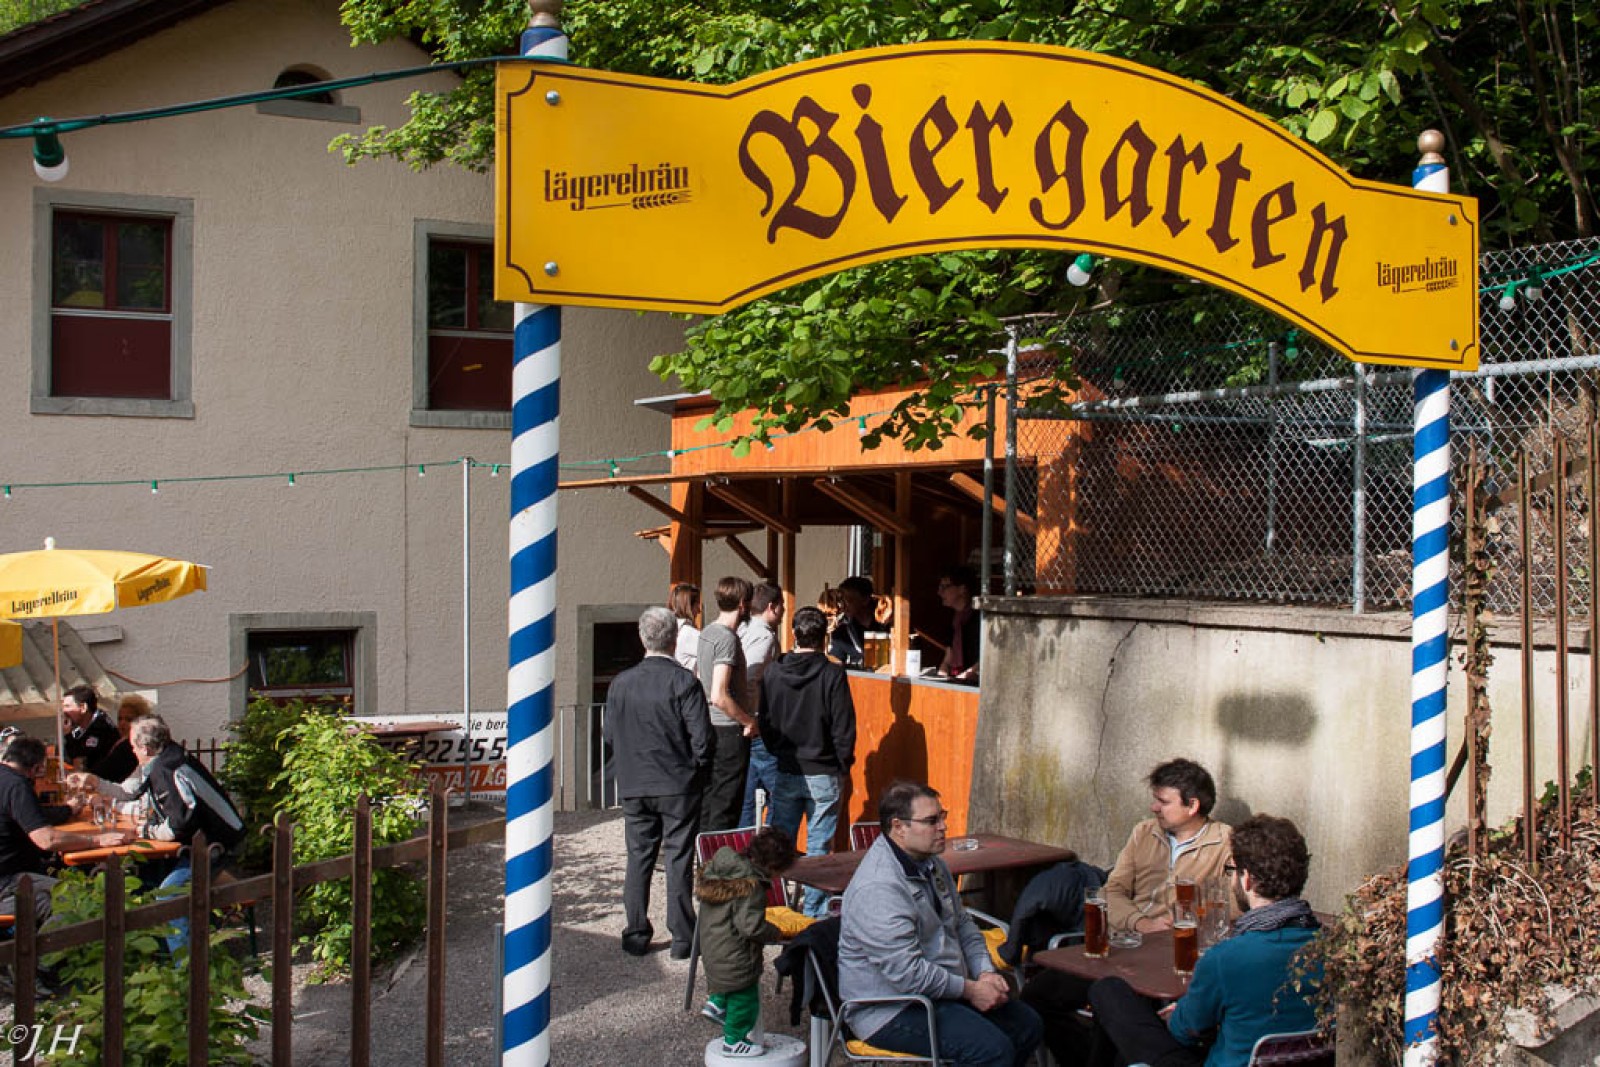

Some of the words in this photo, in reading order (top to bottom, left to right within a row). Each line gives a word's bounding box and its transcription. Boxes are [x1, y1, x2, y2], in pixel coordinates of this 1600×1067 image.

[739, 84, 1348, 304] Biergarten
[485, 718, 508, 731] ber
[489, 737, 507, 760] 5
